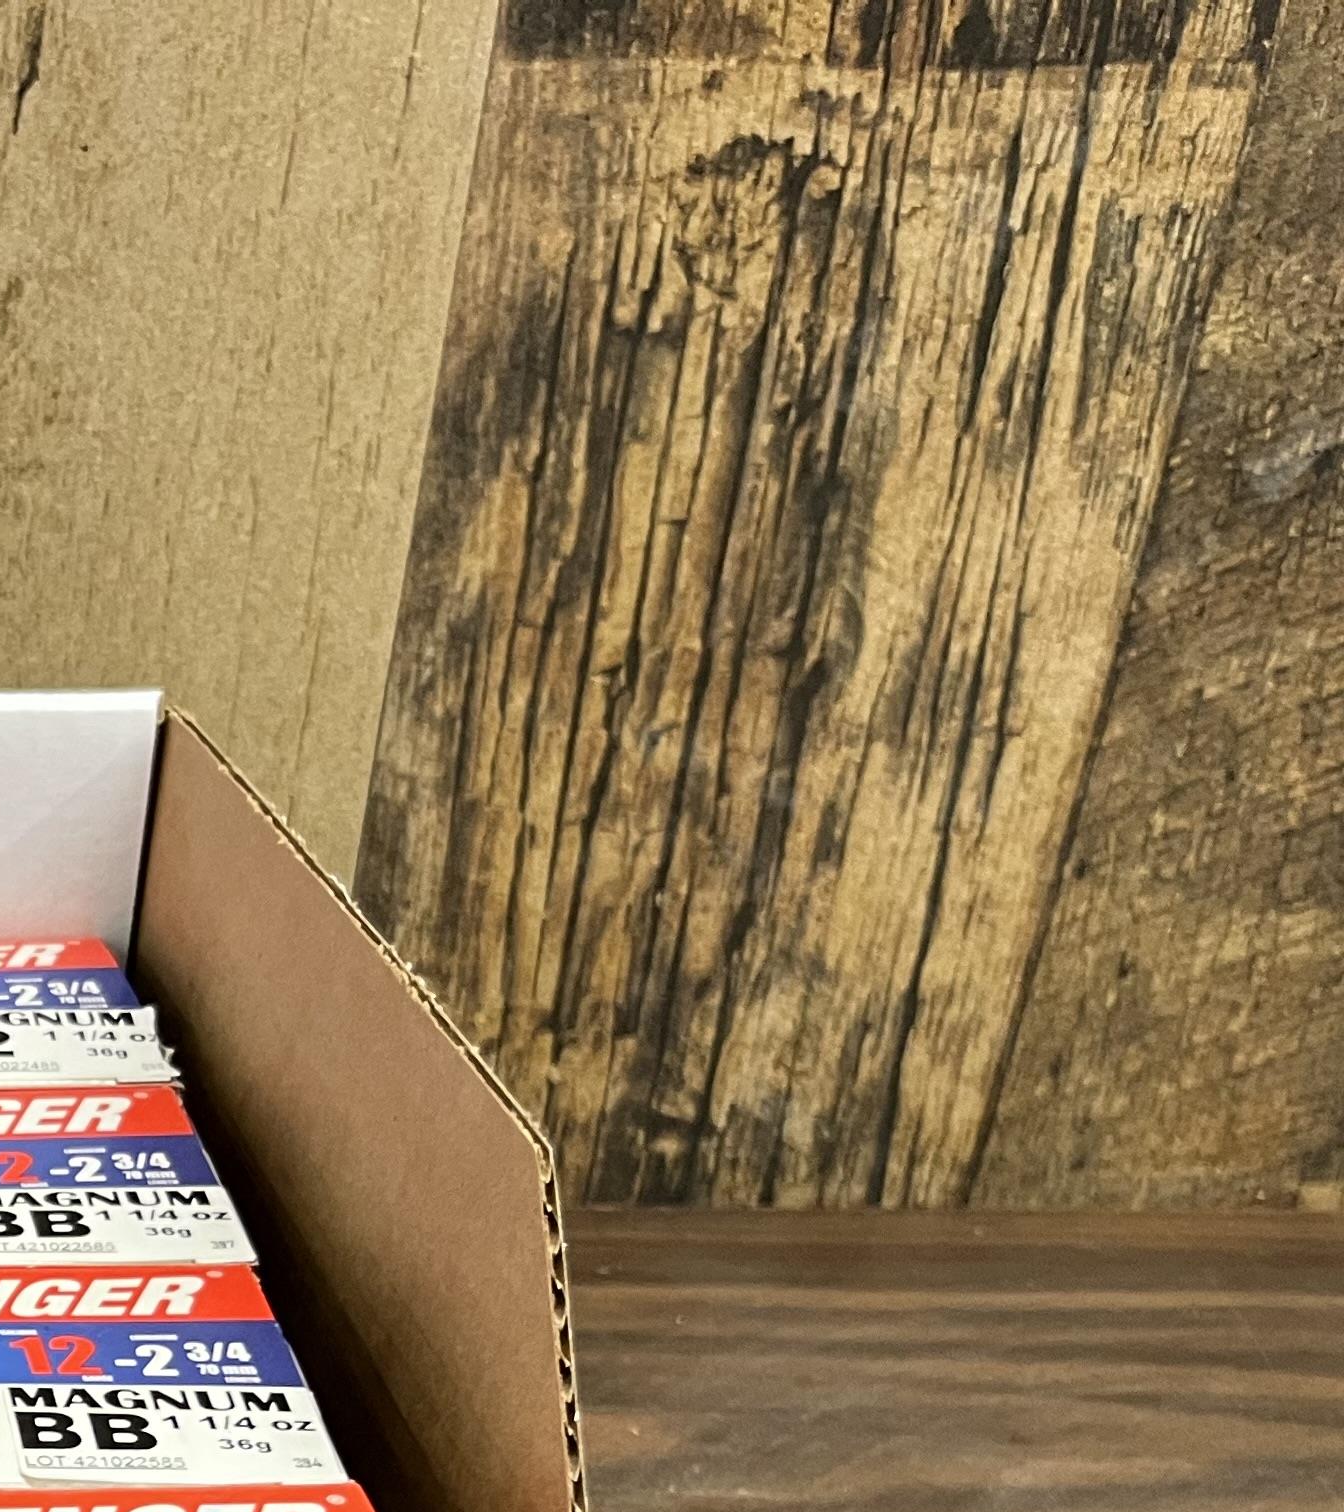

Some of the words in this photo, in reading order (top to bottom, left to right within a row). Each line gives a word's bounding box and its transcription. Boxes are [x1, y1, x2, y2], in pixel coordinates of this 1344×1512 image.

[47, 980, 101, 996] 3/4
[111, 1152, 171, 1171] 3/4
[128, 1210, 179, 1221] 1/4
[191, 1211, 234, 1221] oz
[144, 1227, 193, 1239] 36g
[9, 1335, 103, 1376] 12
[182, 1341, 253, 1363] 3/4
[8, 1386, 292, 1413] MAGNUM
[14, 1411, 159, 1450] BB
[199, 1416, 256, 1431] 1/4
[271, 1419, 318, 1432] oz
[219, 1438, 273, 1454] 36g
